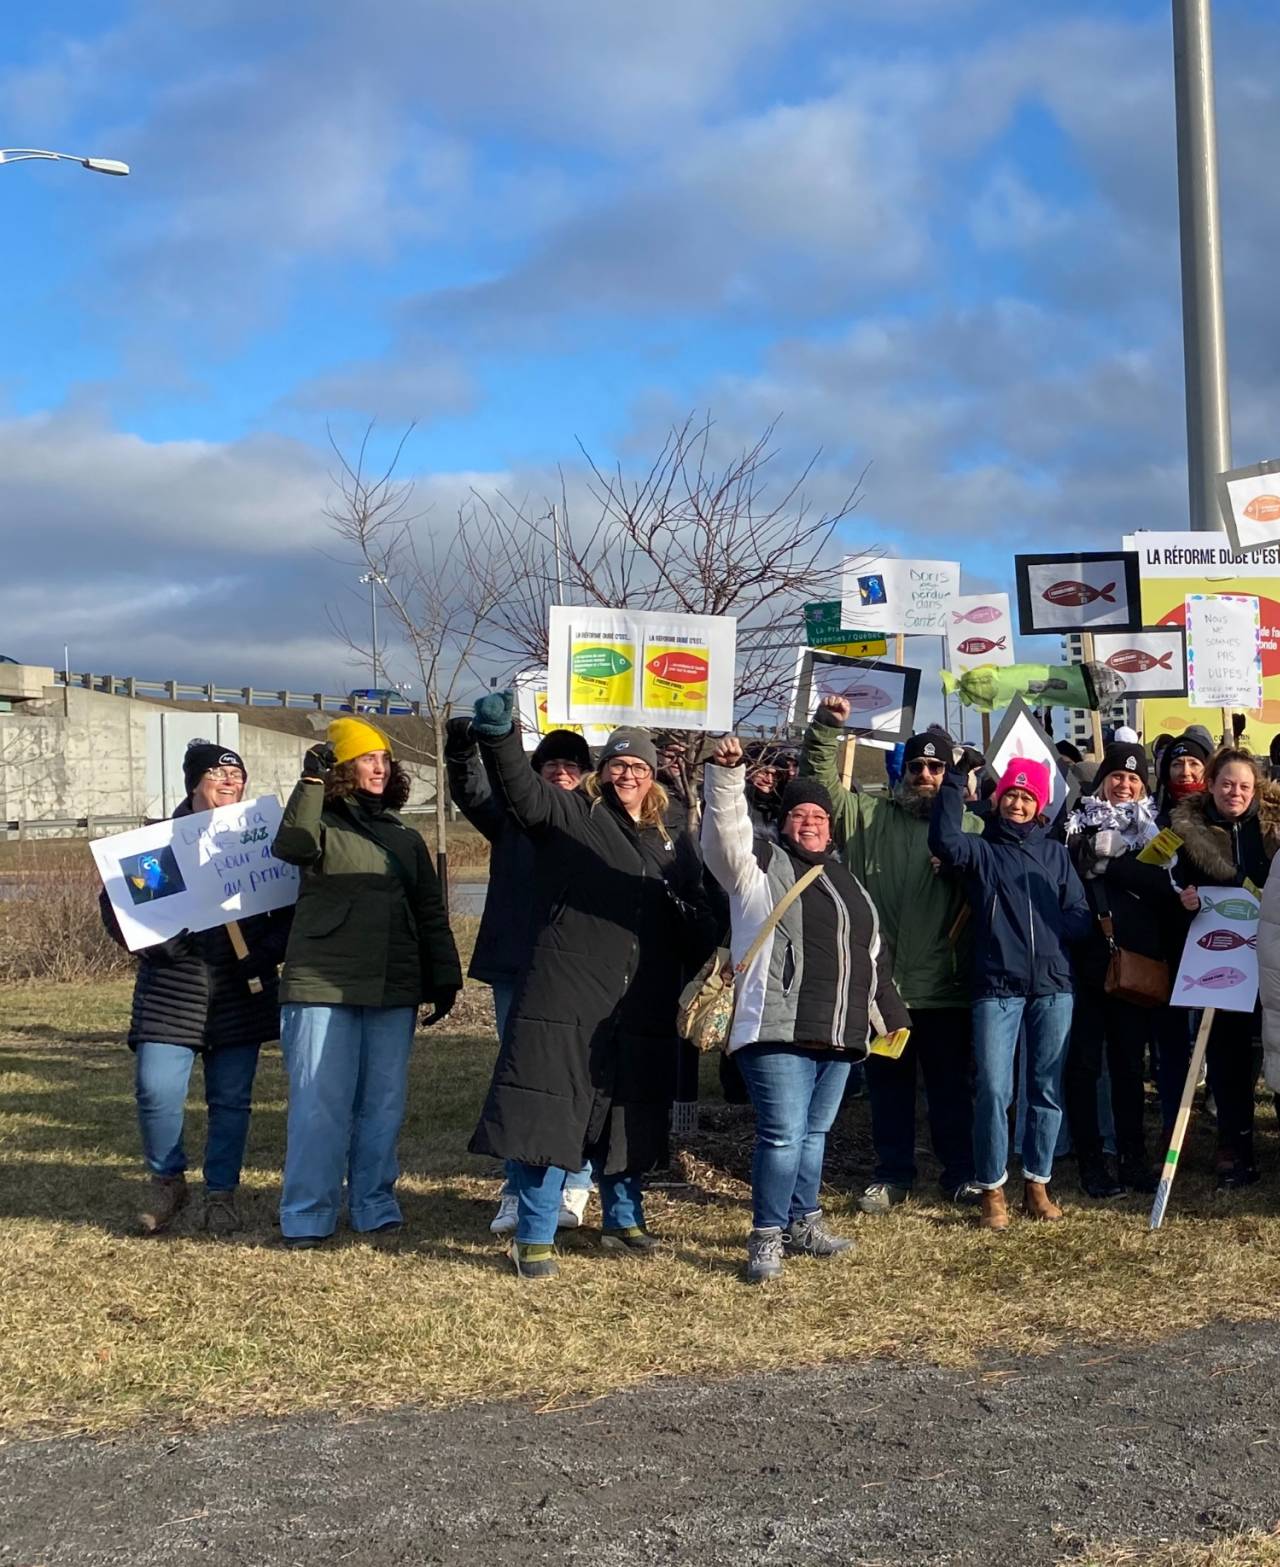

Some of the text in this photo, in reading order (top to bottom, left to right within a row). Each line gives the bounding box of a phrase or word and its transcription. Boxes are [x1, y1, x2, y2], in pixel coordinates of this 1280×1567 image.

[1147, 549, 1160, 565] LA
[1164, 545, 1216, 565] RÉFORME
[223, 879, 243, 897] au
